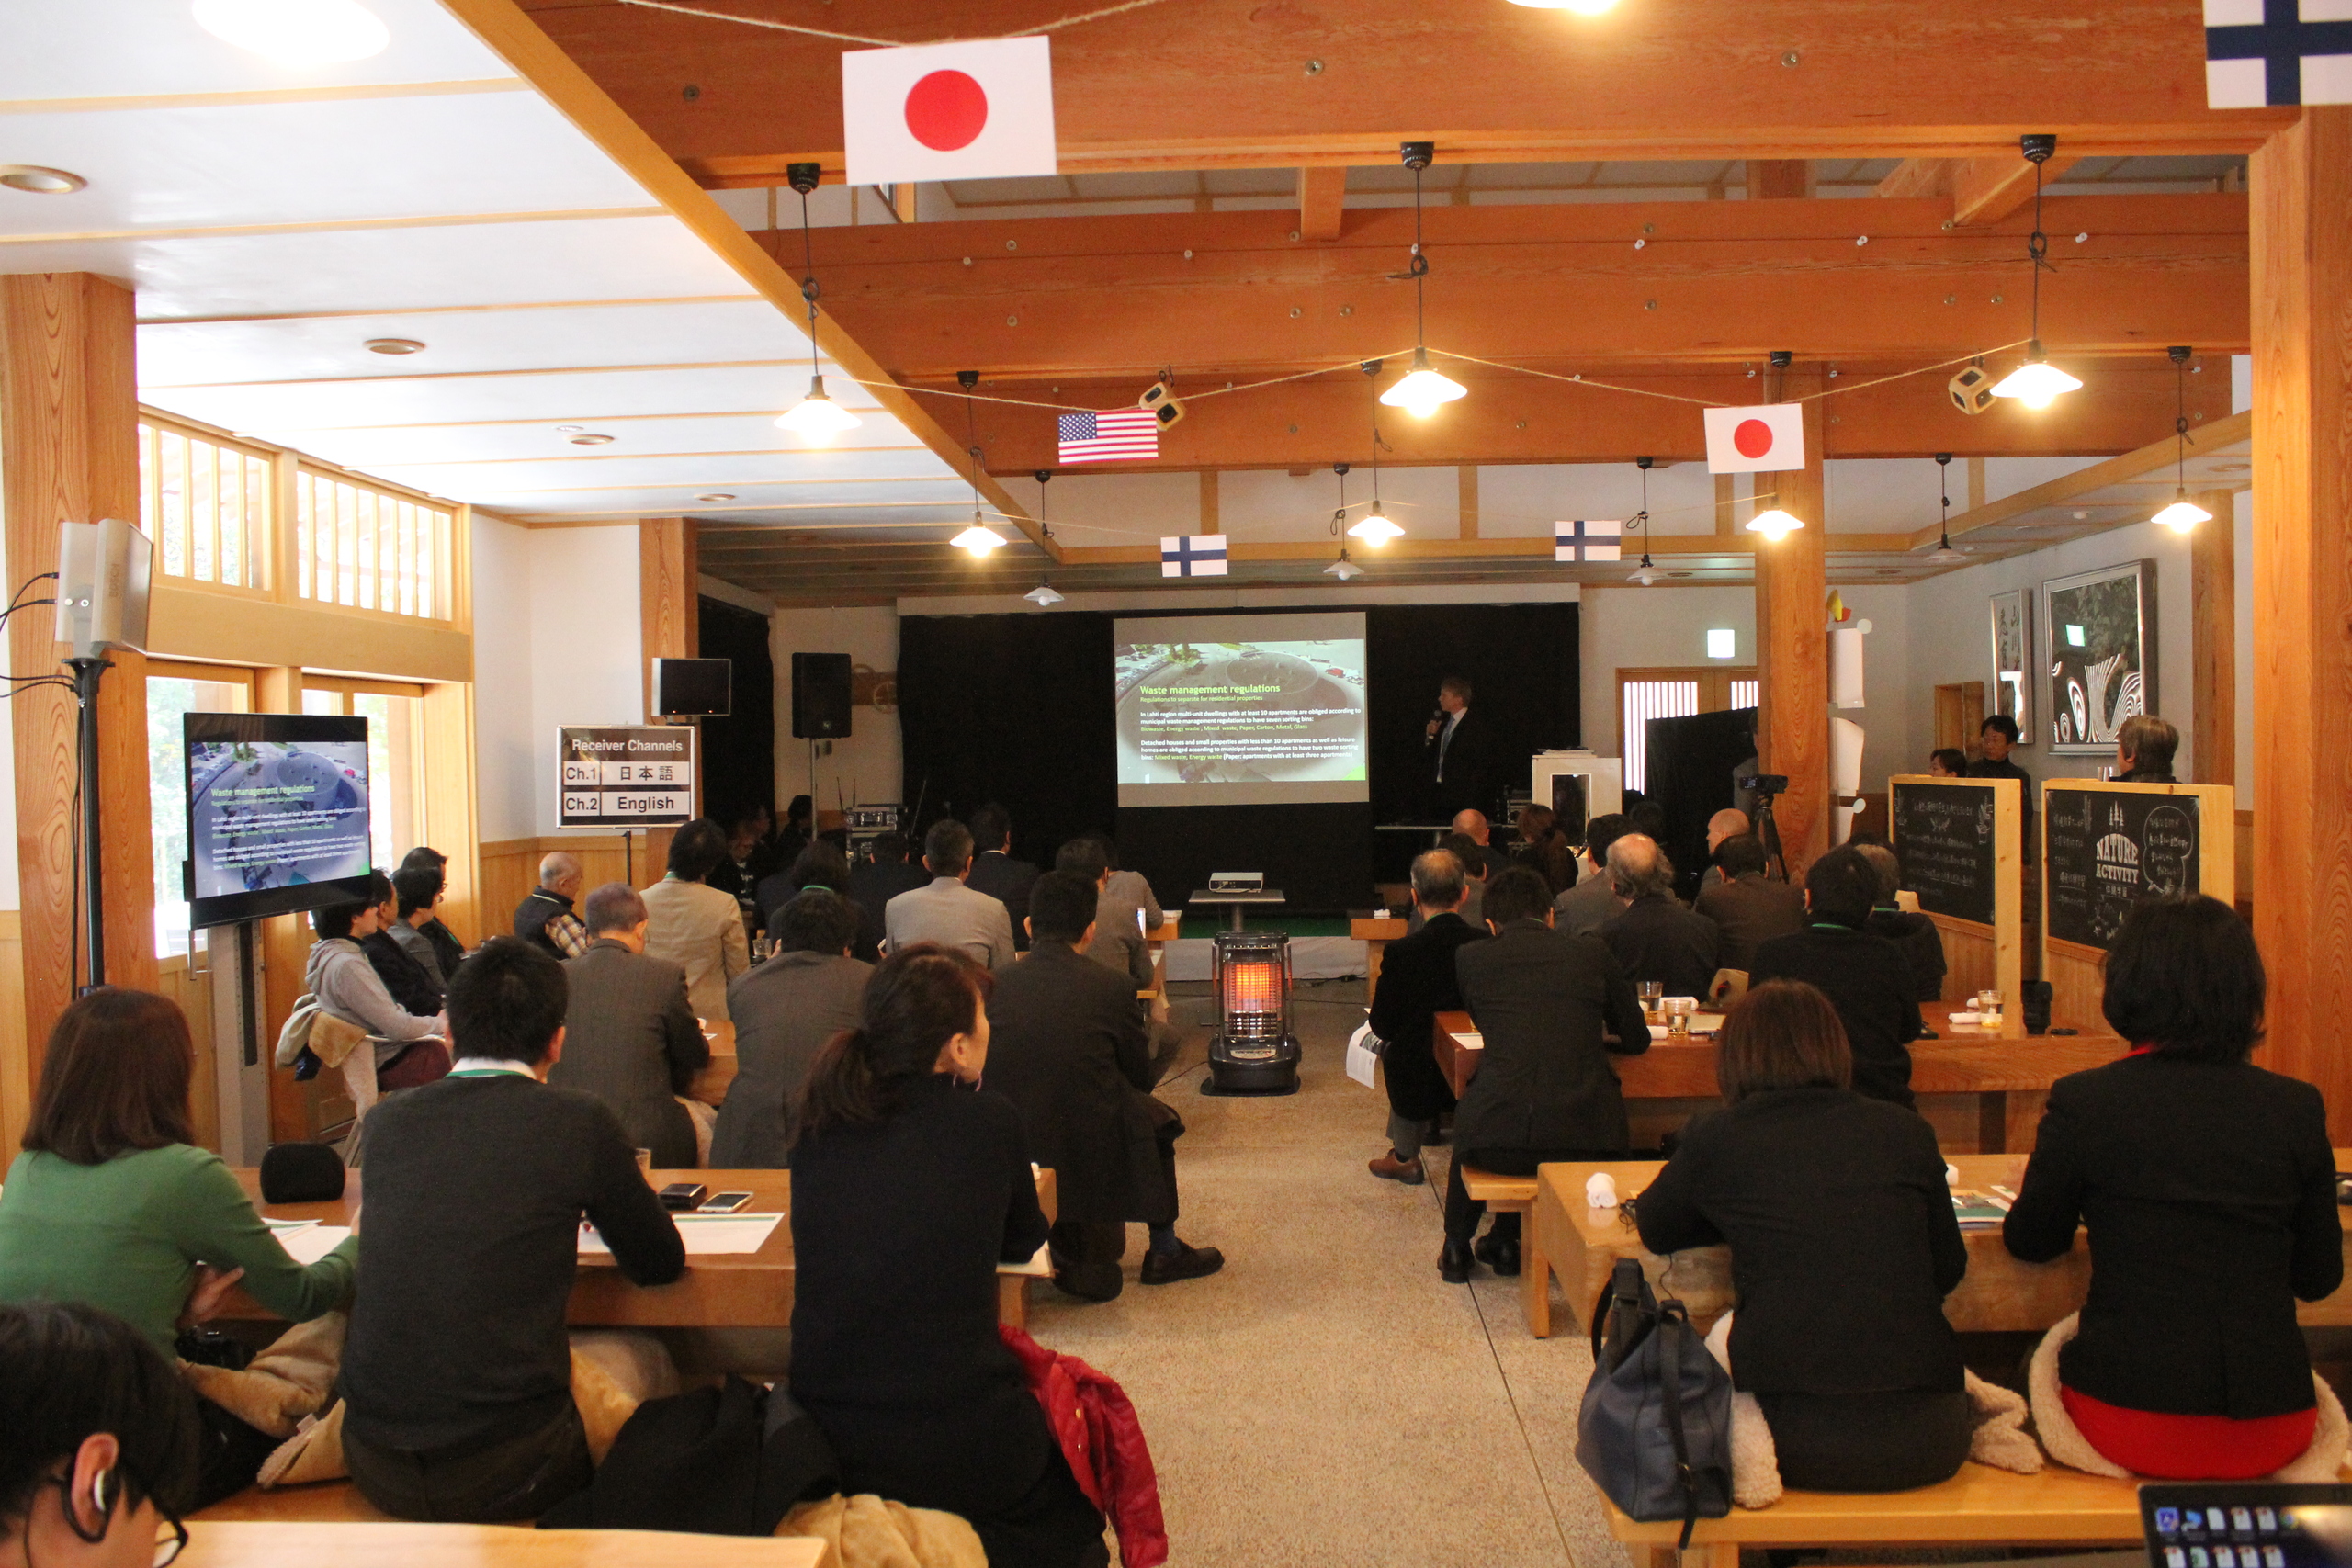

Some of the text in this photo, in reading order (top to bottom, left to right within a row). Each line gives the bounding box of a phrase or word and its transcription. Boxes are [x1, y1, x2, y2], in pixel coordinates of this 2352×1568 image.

[1170, 685, 1228, 695] management
[1230, 685, 1280, 694] regulations
[572, 739, 683, 751] Receiver Channels
[566, 766, 673, 781] Ch.1 日本語
[234, 787, 278, 797] management
[279, 786, 315, 795] regulations
[566, 797, 674, 812] Ch.2 English
[2096, 833, 2138, 865] NATURE
[2096, 864, 2138, 884] ACTIVITY
